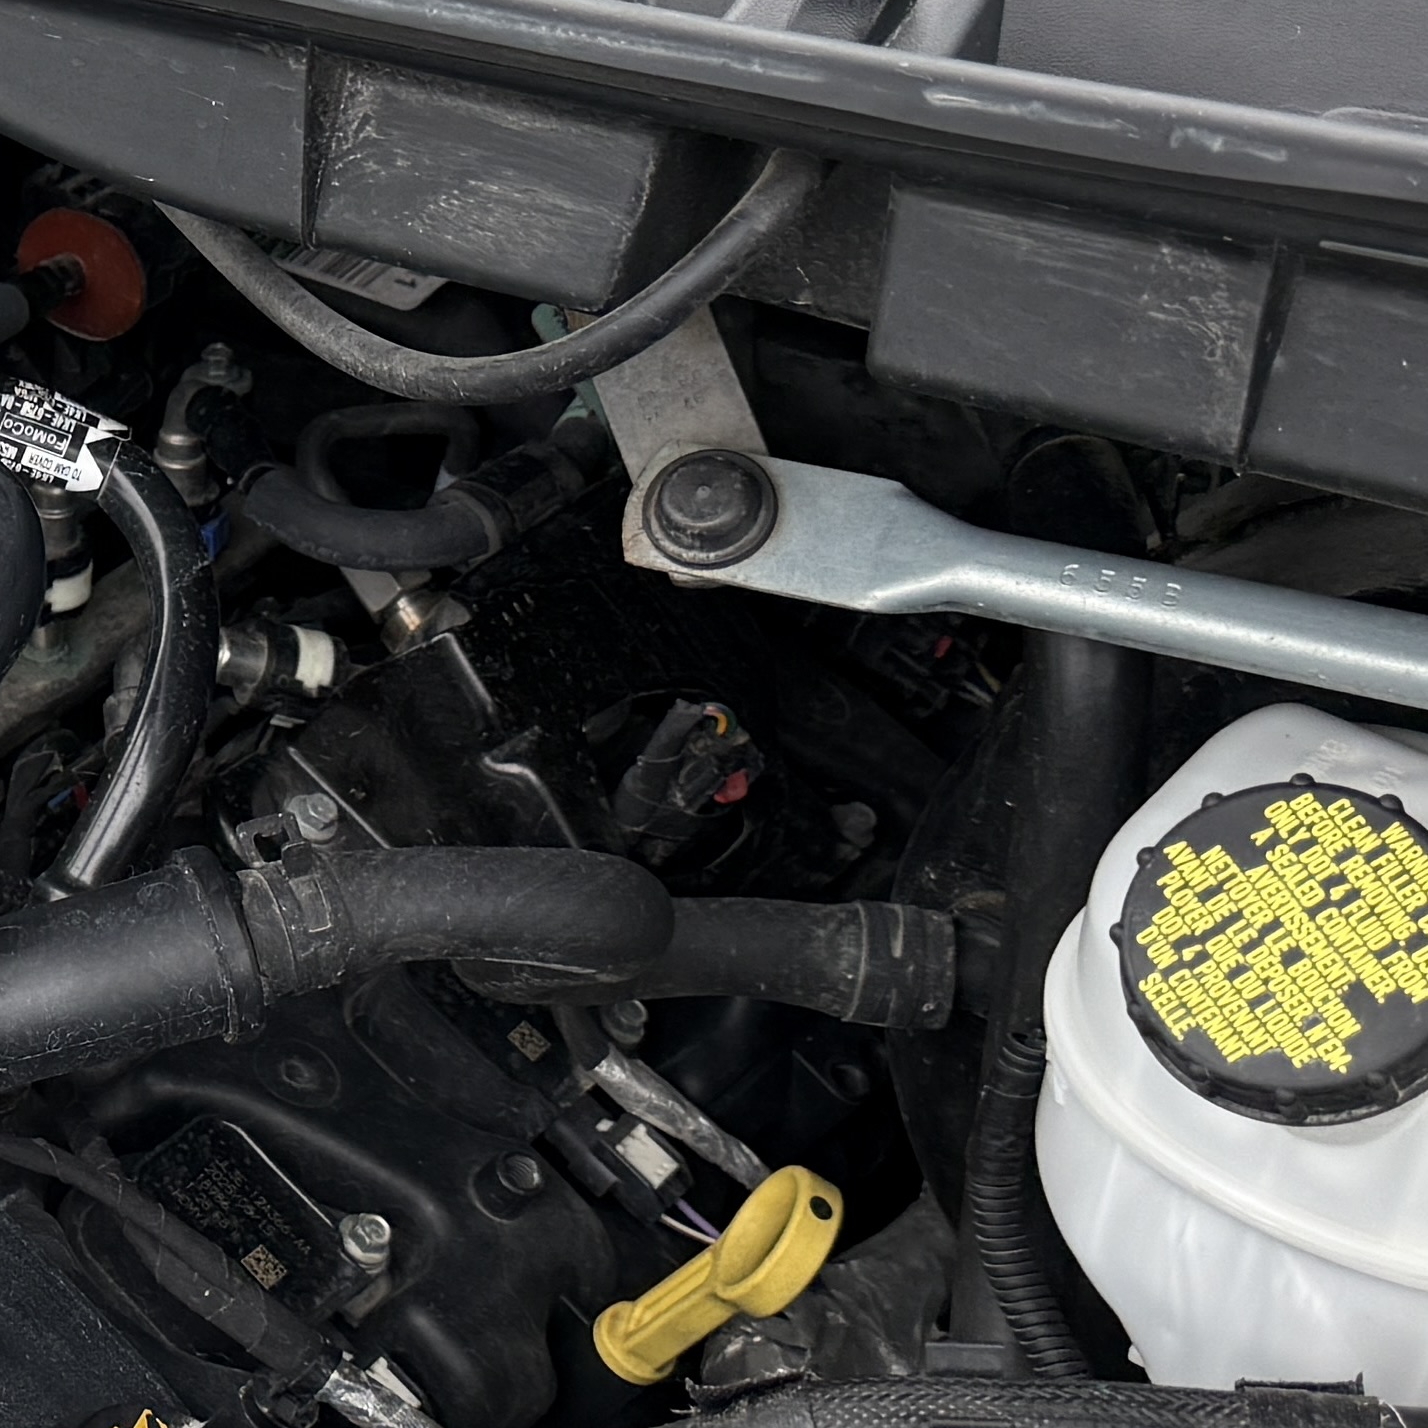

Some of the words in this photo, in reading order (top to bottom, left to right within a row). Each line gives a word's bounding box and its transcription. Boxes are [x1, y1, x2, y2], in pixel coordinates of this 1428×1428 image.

[2, 417, 68, 452] FoMoCo
[1265, 801, 1310, 850] ONLY
[1288, 794, 1351, 859] BEFORE
[1336, 854, 1417, 945] REMOVING.
[1297, 840, 1339, 883] DOT
[1326, 800, 1382, 861] CLEAN
[1368, 852, 1427, 914] FILLER
[1152, 905, 1191, 944] DOT
[1240, 865, 1356, 997] AVERTISSEMENT:
[1251, 827, 1274, 846] A
[1265, 843, 1325, 909] SEALED
[1314, 908, 1396, 1002] CONTAINER.
[1331, 882, 1352, 902] 4
[1340, 898, 1392, 952] FLUID
[1158, 869, 1214, 935] PLOYER
[1203, 933, 1245, 975] QUE
[1231, 970, 1266, 1001] DU
[1250, 1000, 1318, 1069] LIQUIDE
[1165, 843, 1217, 894] AVANT
[1202, 892, 1238, 924] DE
[1224, 916, 1258, 950] LE
[1299, 1022, 1350, 1072] N'EM-
[1182, 946, 1201, 963] 4
[1197, 848, 1276, 936] NETTOYER
[1264, 927, 1297, 963] LE
[1285, 957, 1361, 1041] BOUCHON
[1380, 950, 1428, 1005] FROM
[1137, 926, 1178, 971] D'UN
[1167, 970, 1251, 1064] CONTENANT
[1187, 958, 1278, 1057] PROVENANT
